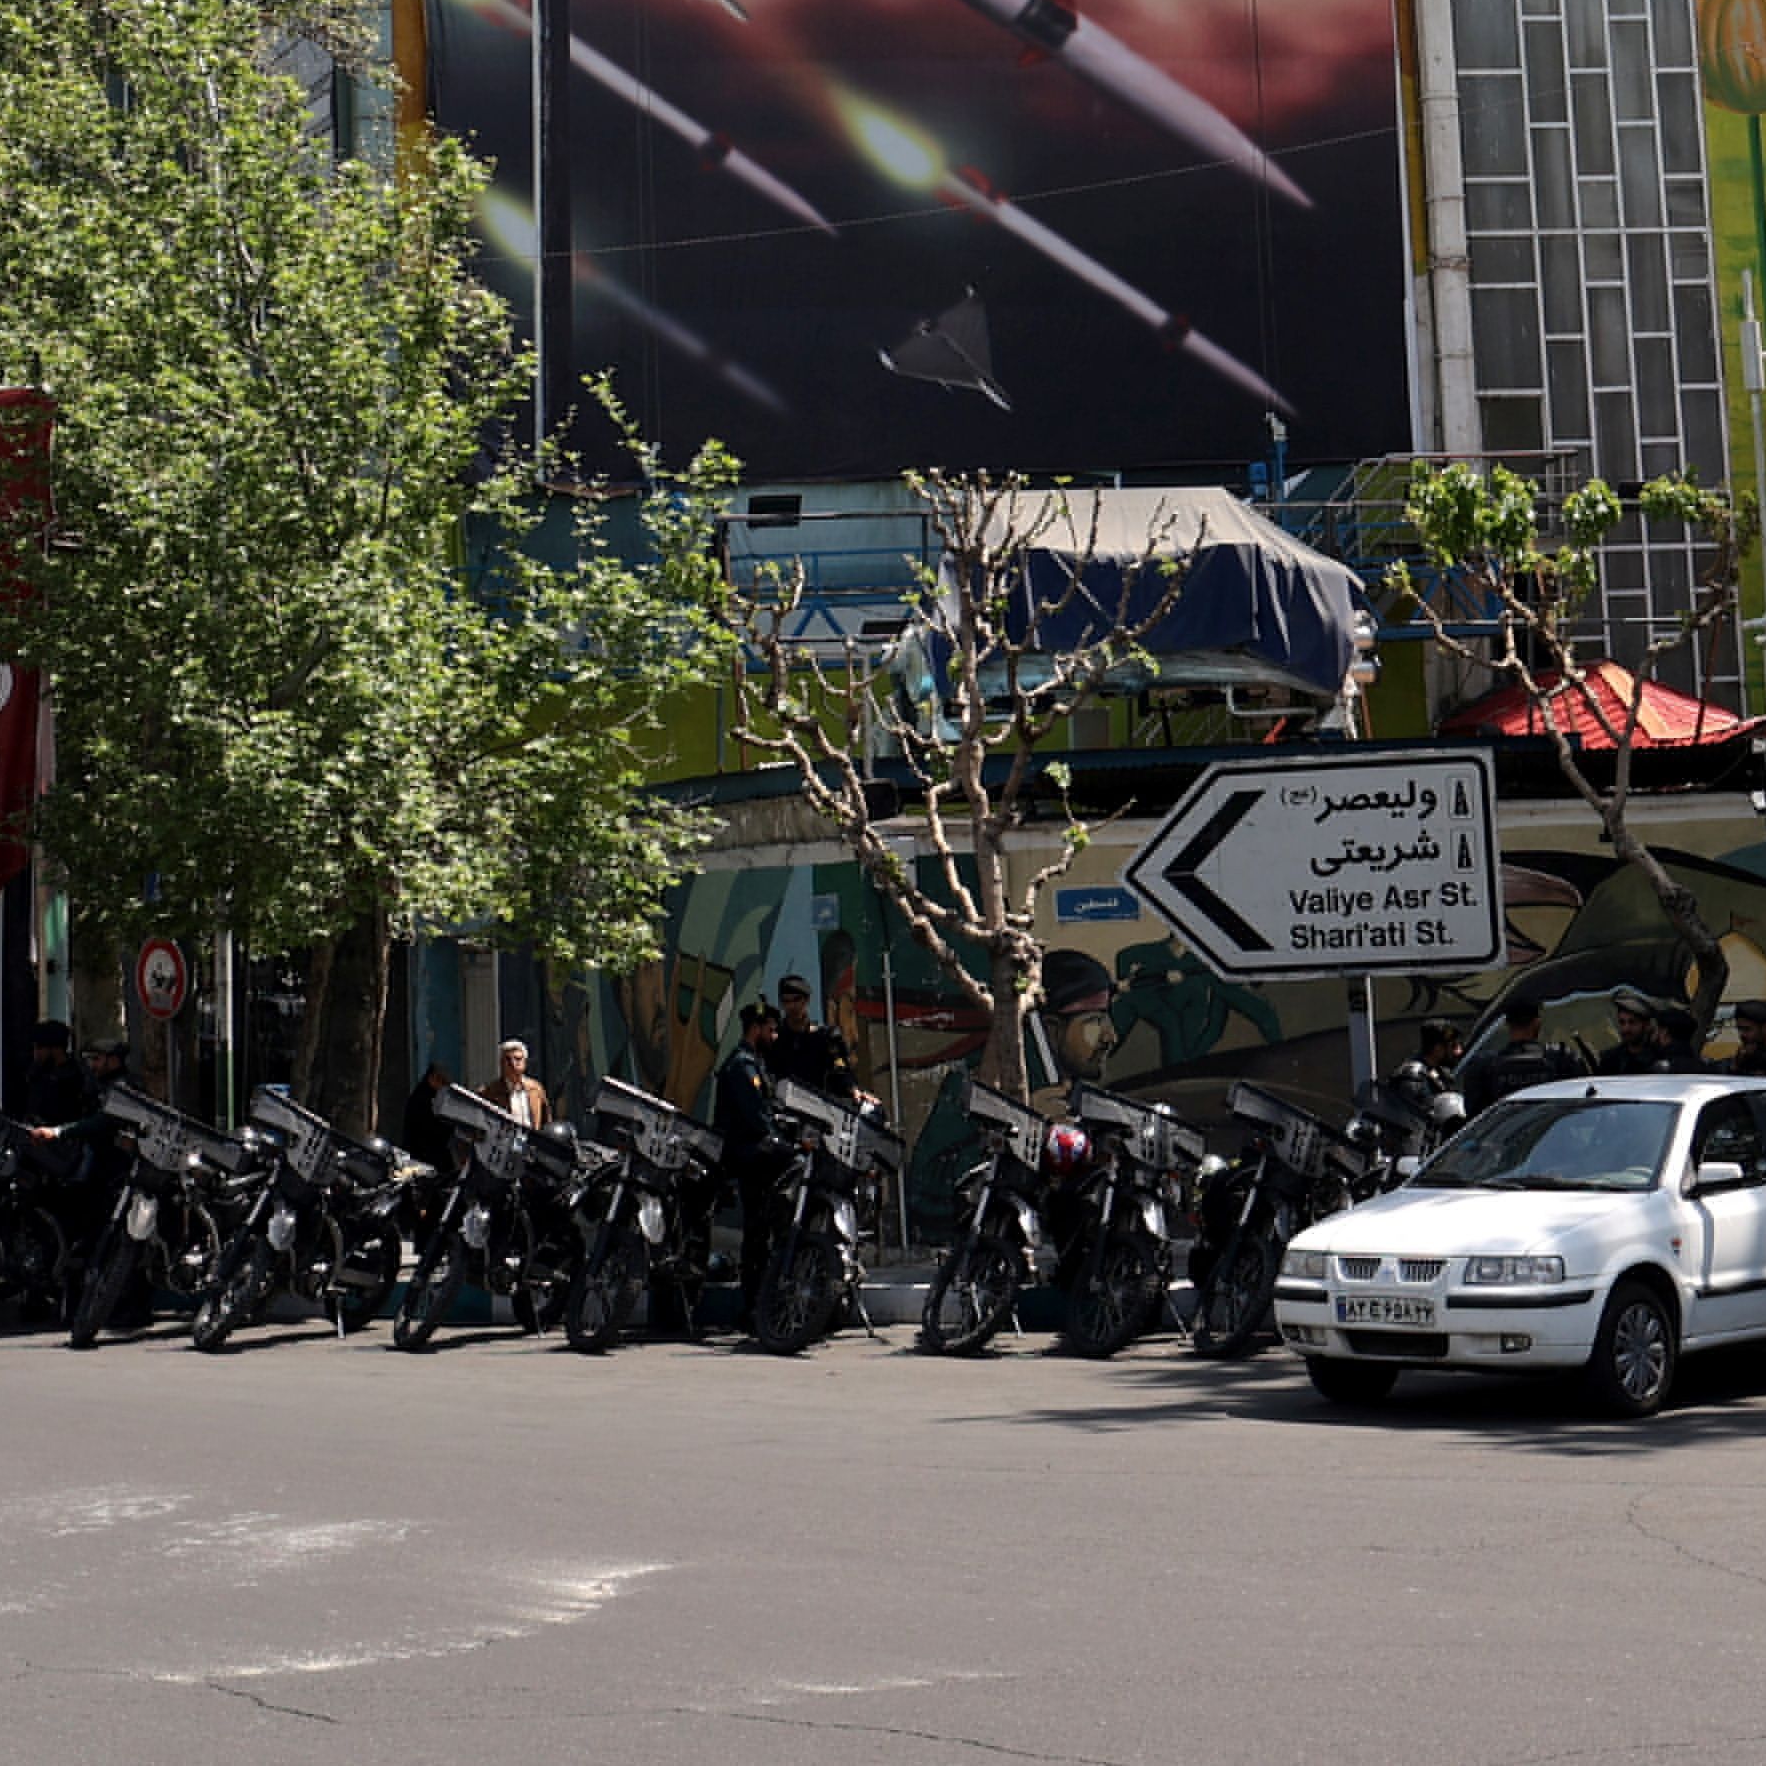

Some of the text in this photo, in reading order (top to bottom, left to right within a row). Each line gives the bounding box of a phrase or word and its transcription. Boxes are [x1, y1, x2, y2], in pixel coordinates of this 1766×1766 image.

[1313, 779, 1438, 824] ولیعصر
[1309, 829, 1441, 877] شریعتی
[1289, 881, 1478, 918] Valiye Asr St.
[1289, 919, 1455, 951] Shari'ati St.
